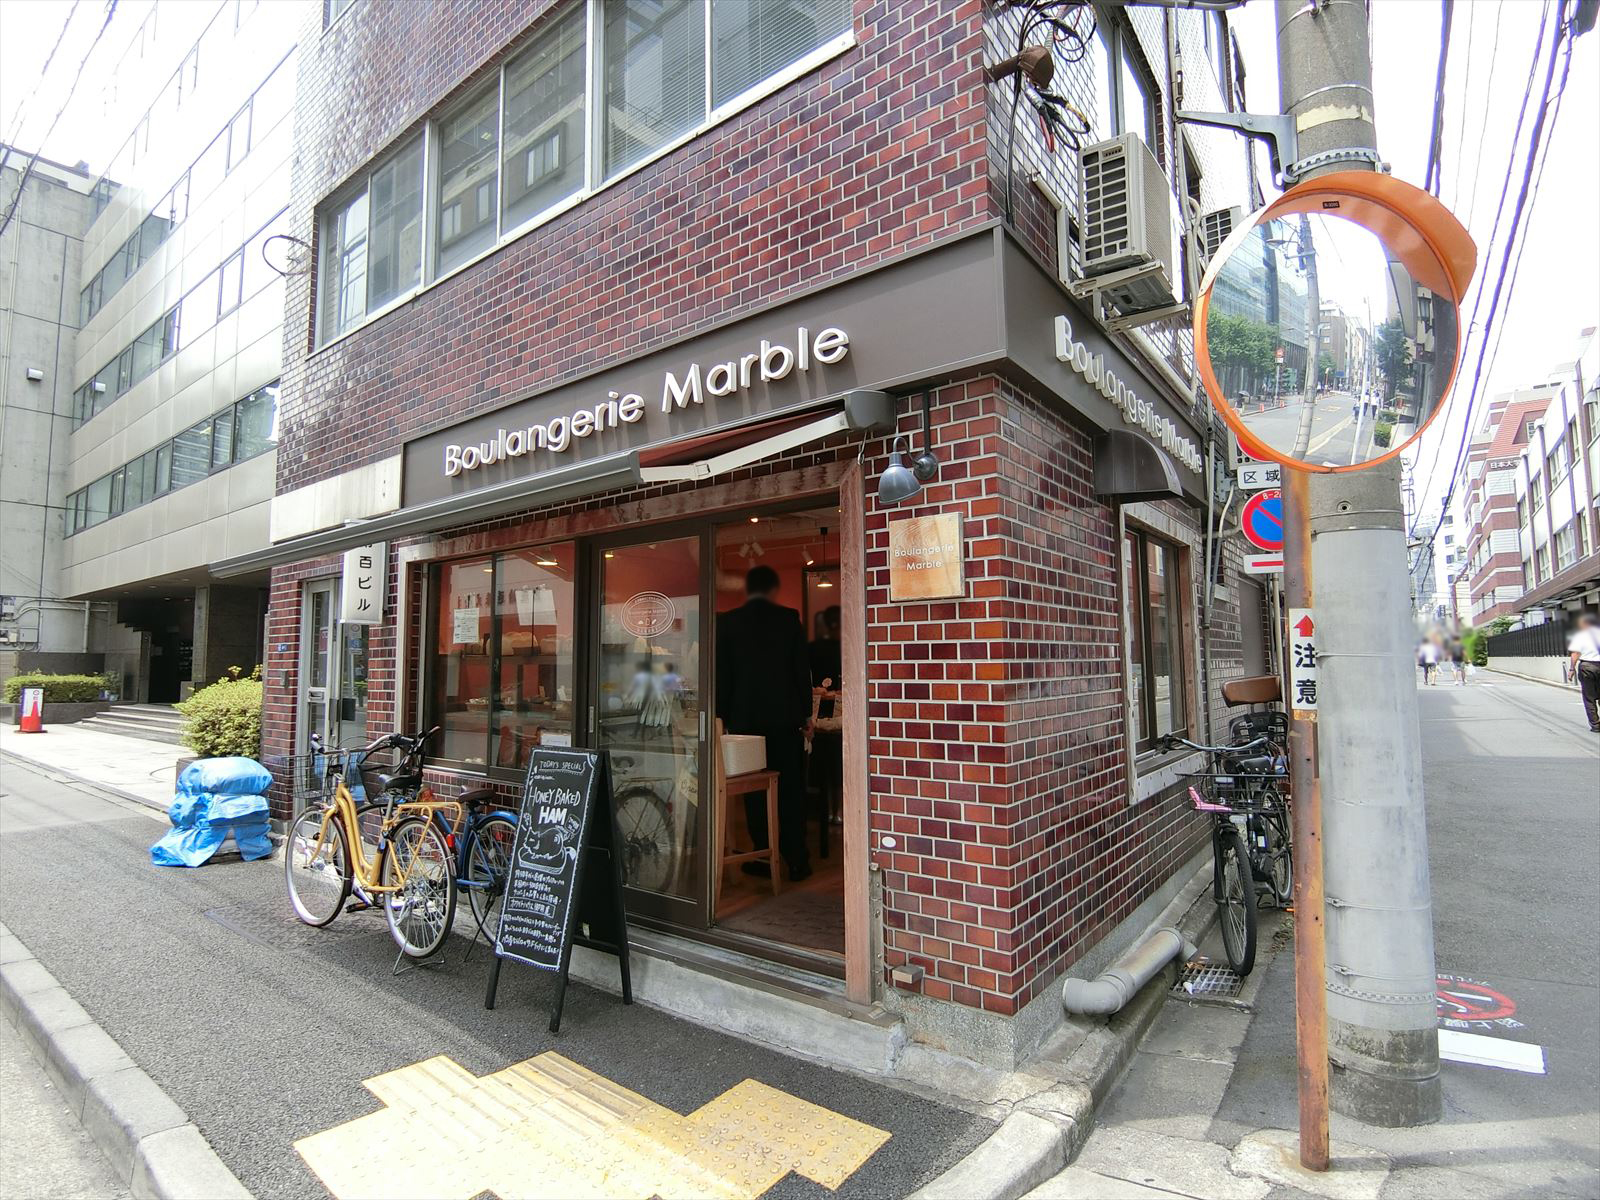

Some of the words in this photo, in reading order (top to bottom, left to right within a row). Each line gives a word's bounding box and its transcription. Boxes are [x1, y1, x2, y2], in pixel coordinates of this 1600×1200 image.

[1054, 314, 1162, 438] Boulangerie
[444, 391, 645, 478] Boulangerie
[661, 327, 850, 413] Marble
[1243, 469, 1280, 483] 区域
[1262, 490, 1281, 500] 8-2
[894, 543, 954, 557] Boulangerie
[906, 560, 942, 571] Marble
[357, 544, 373, 612] 百ビル
[1294, 642, 1317, 704] 注意
[527, 786, 555, 807] HONEY
[554, 788, 581, 807] BAKED
[538, 806, 568, 825] HAM
